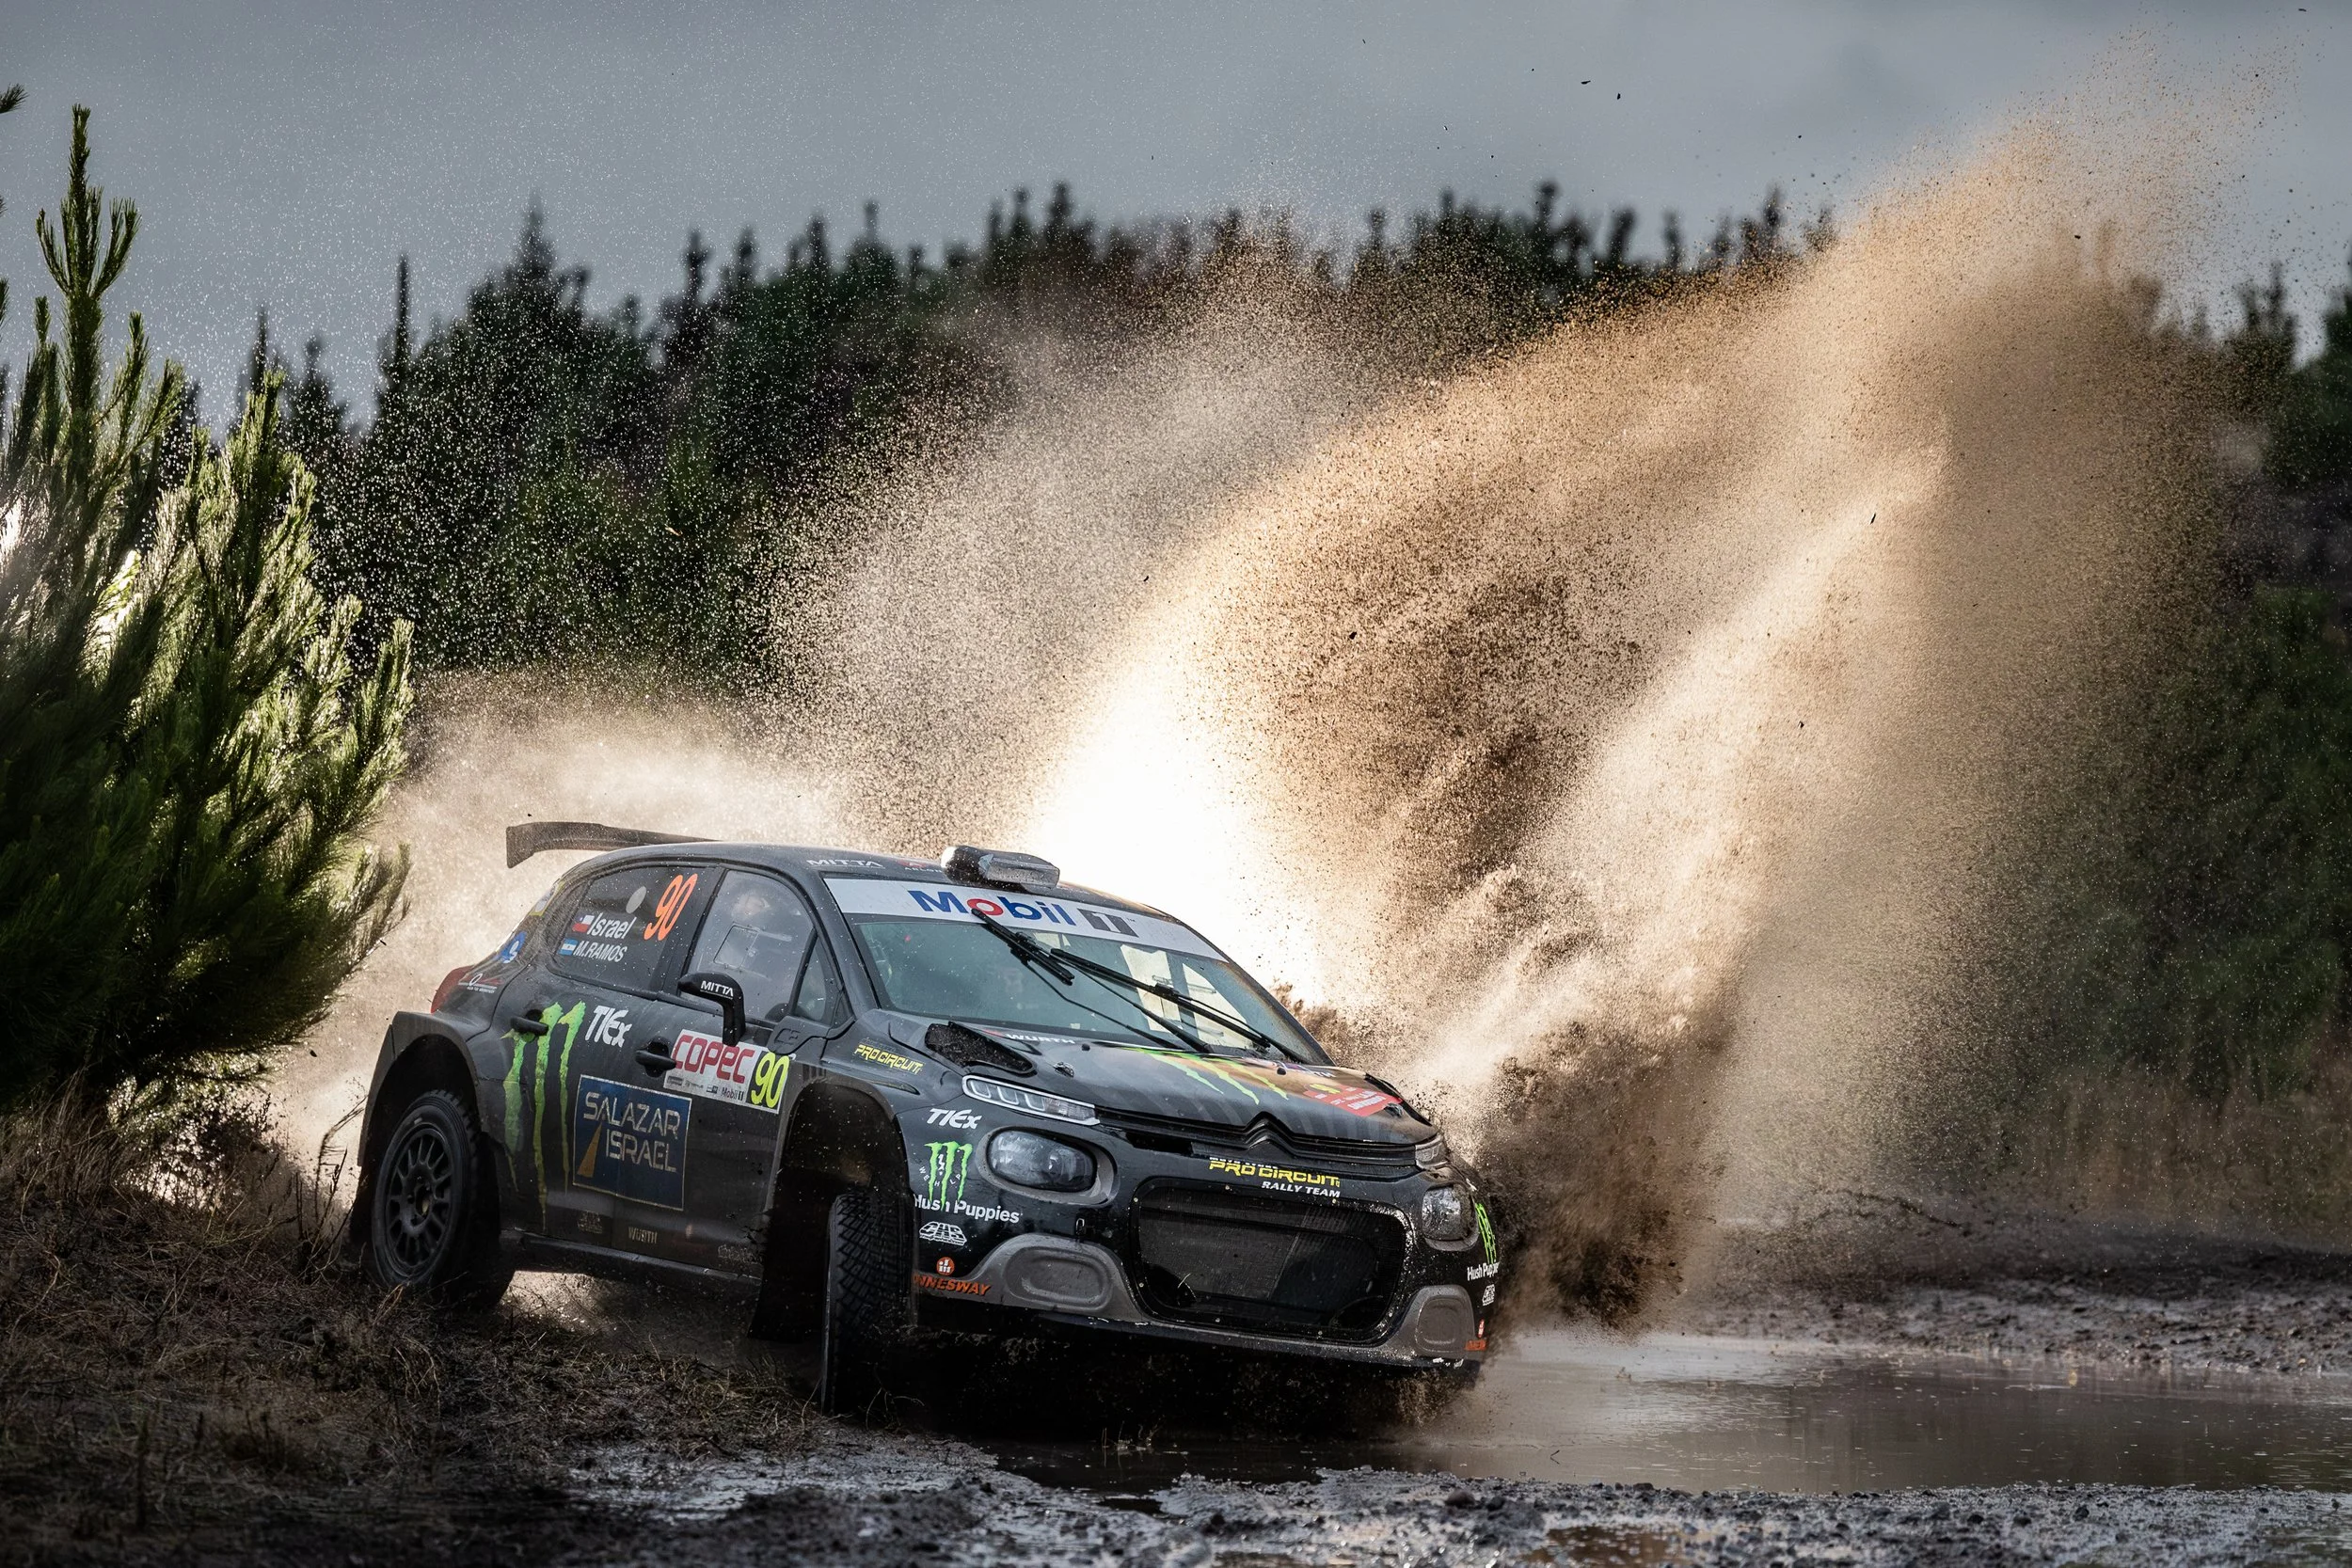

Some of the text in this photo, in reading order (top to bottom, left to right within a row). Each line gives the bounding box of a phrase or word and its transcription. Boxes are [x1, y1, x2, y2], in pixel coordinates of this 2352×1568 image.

[806, 859, 883, 867] MITTA
[644, 873, 698, 941] 90
[908, 890, 1076, 927] Mobil
[587, 912, 637, 940] Israel
[573, 941, 628, 963] M.RAMOS
[701, 980, 734, 997] MITTA
[853, 1044, 880, 1061] PRO
[878, 1050, 924, 1075] CIRCUIT
[751, 1051, 789, 1108] 90
[583, 1091, 681, 1139] SALAZAR
[606, 1128, 676, 1173] ISRAEL
[1209, 1160, 1256, 1176] PRO
[1258, 1166, 1340, 1187] CIRCUIT
[1262, 1180, 1341, 1198] RALLY TEAM
[953, 1199, 1020, 1223] Puppies
[1468, 1264, 1483, 1281] Hush
